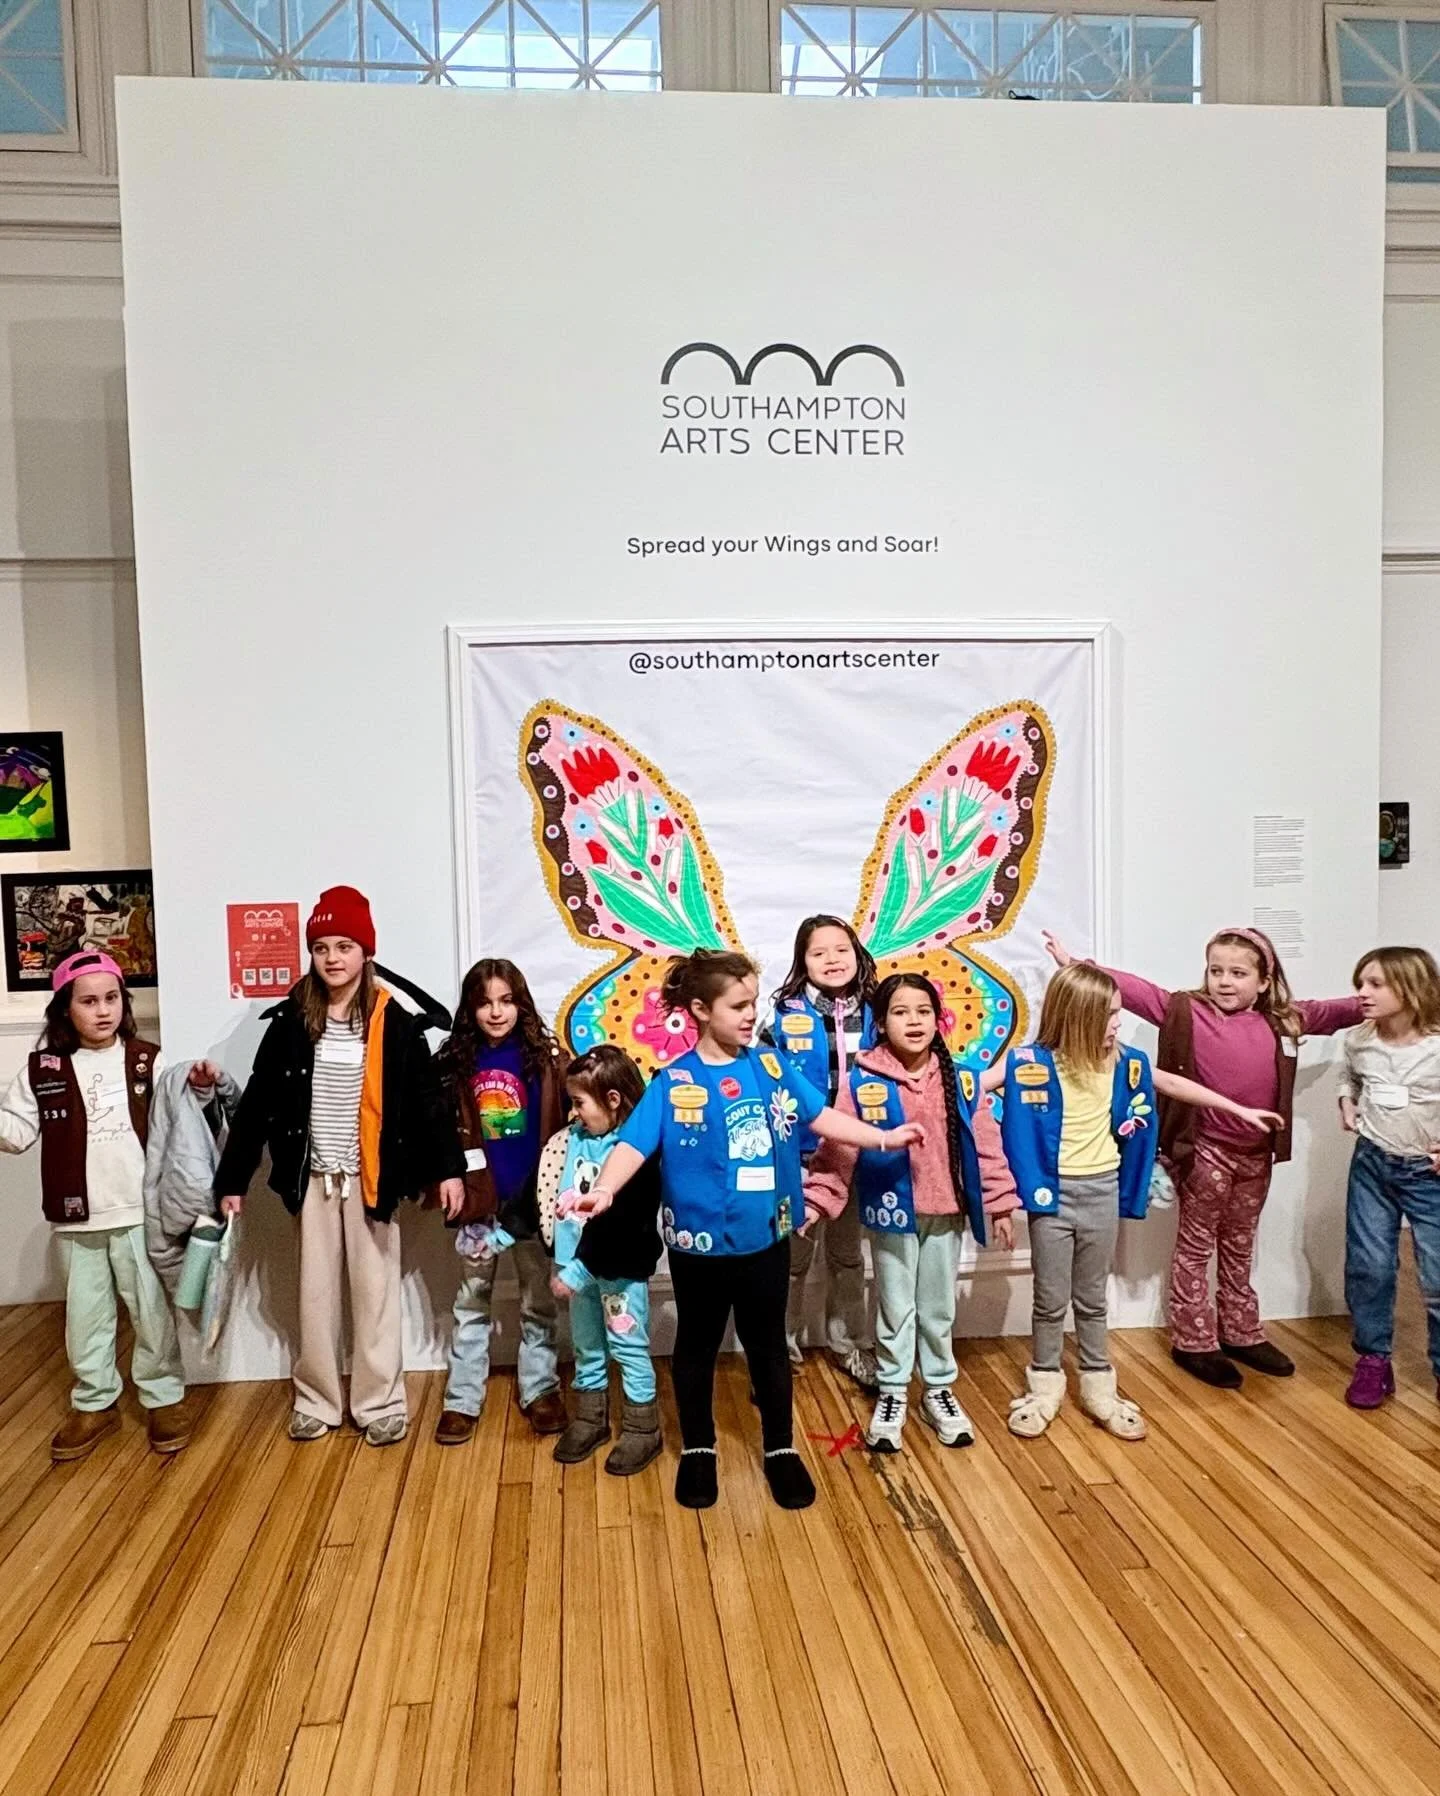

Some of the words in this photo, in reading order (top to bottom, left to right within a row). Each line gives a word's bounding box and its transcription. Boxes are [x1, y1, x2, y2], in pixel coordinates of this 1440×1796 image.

[661, 395, 906, 421] SOUTHAMPTON
[660, 427, 750, 455] ARTS
[767, 428, 905, 456] CENTER
[626, 535, 705, 558] Spread
[711, 539, 759, 557] your
[764, 534, 831, 557] Wings
[837, 535, 878, 554] and
[884, 535, 939, 554] Soar!
[628, 649, 940, 675] @southamptonartscenter
